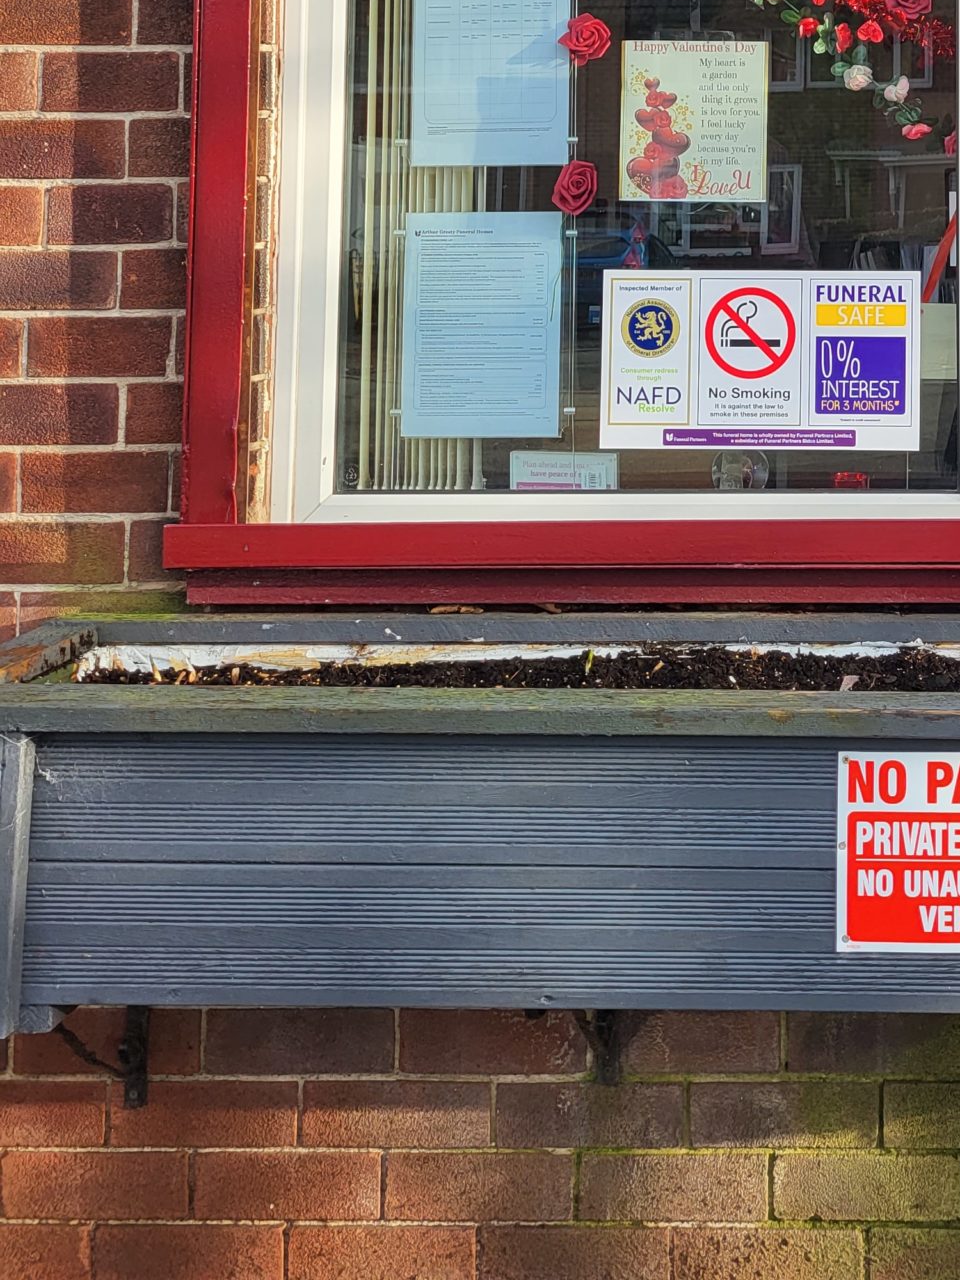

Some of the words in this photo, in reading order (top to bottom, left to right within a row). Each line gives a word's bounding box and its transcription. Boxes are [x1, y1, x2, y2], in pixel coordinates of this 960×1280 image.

[634, 41, 670, 55] Happy
[672, 41, 730, 53] Valentine's
[734, 42, 757, 55] Day
[700, 58, 712, 68] My
[714, 58, 736, 66] heart
[739, 58, 746, 66] is
[708, 70, 738, 81] garden
[698, 83, 714, 91] and
[716, 83, 730, 91] the
[732, 84, 750, 94] only
[702, 95, 724, 106] thing
[725, 96, 732, 104] it
[734, 96, 758, 106] grows
[701, 108, 708, 116] is
[710, 108, 728, 116] love
[730, 108, 742, 116] for
[744, 110, 760, 118] you.
[701, 120, 705, 128] I
[707, 120, 722, 128] feel
[724, 120, 746, 130] lucky
[700, 133, 722, 142] every
[724, 132, 739, 142] day
[698, 144, 729, 152] because
[731, 144, 756, 154] you're
[700, 156, 708, 164] in
[711, 158, 724, 166] my
[725, 156, 740, 165] life.
[688, 170, 739, 196] Love
[733, 170, 751, 190] U
[816, 285, 907, 302] FUNERAL
[626, 300, 646, 317] National
[837, 306, 886, 325] SAFE
[631, 345, 650, 357] Funeral
[616, 386, 682, 404] NAFD
[708, 388, 727, 399] No
[732, 387, 791, 402] Smoking
[821, 380, 900, 399] INTEREST
[638, 403, 676, 413] Resolve
[821, 400, 840, 410] FOR
[843, 400, 850, 410] 3
[847, 760, 907, 804] NO
[857, 869, 894, 897] NO
